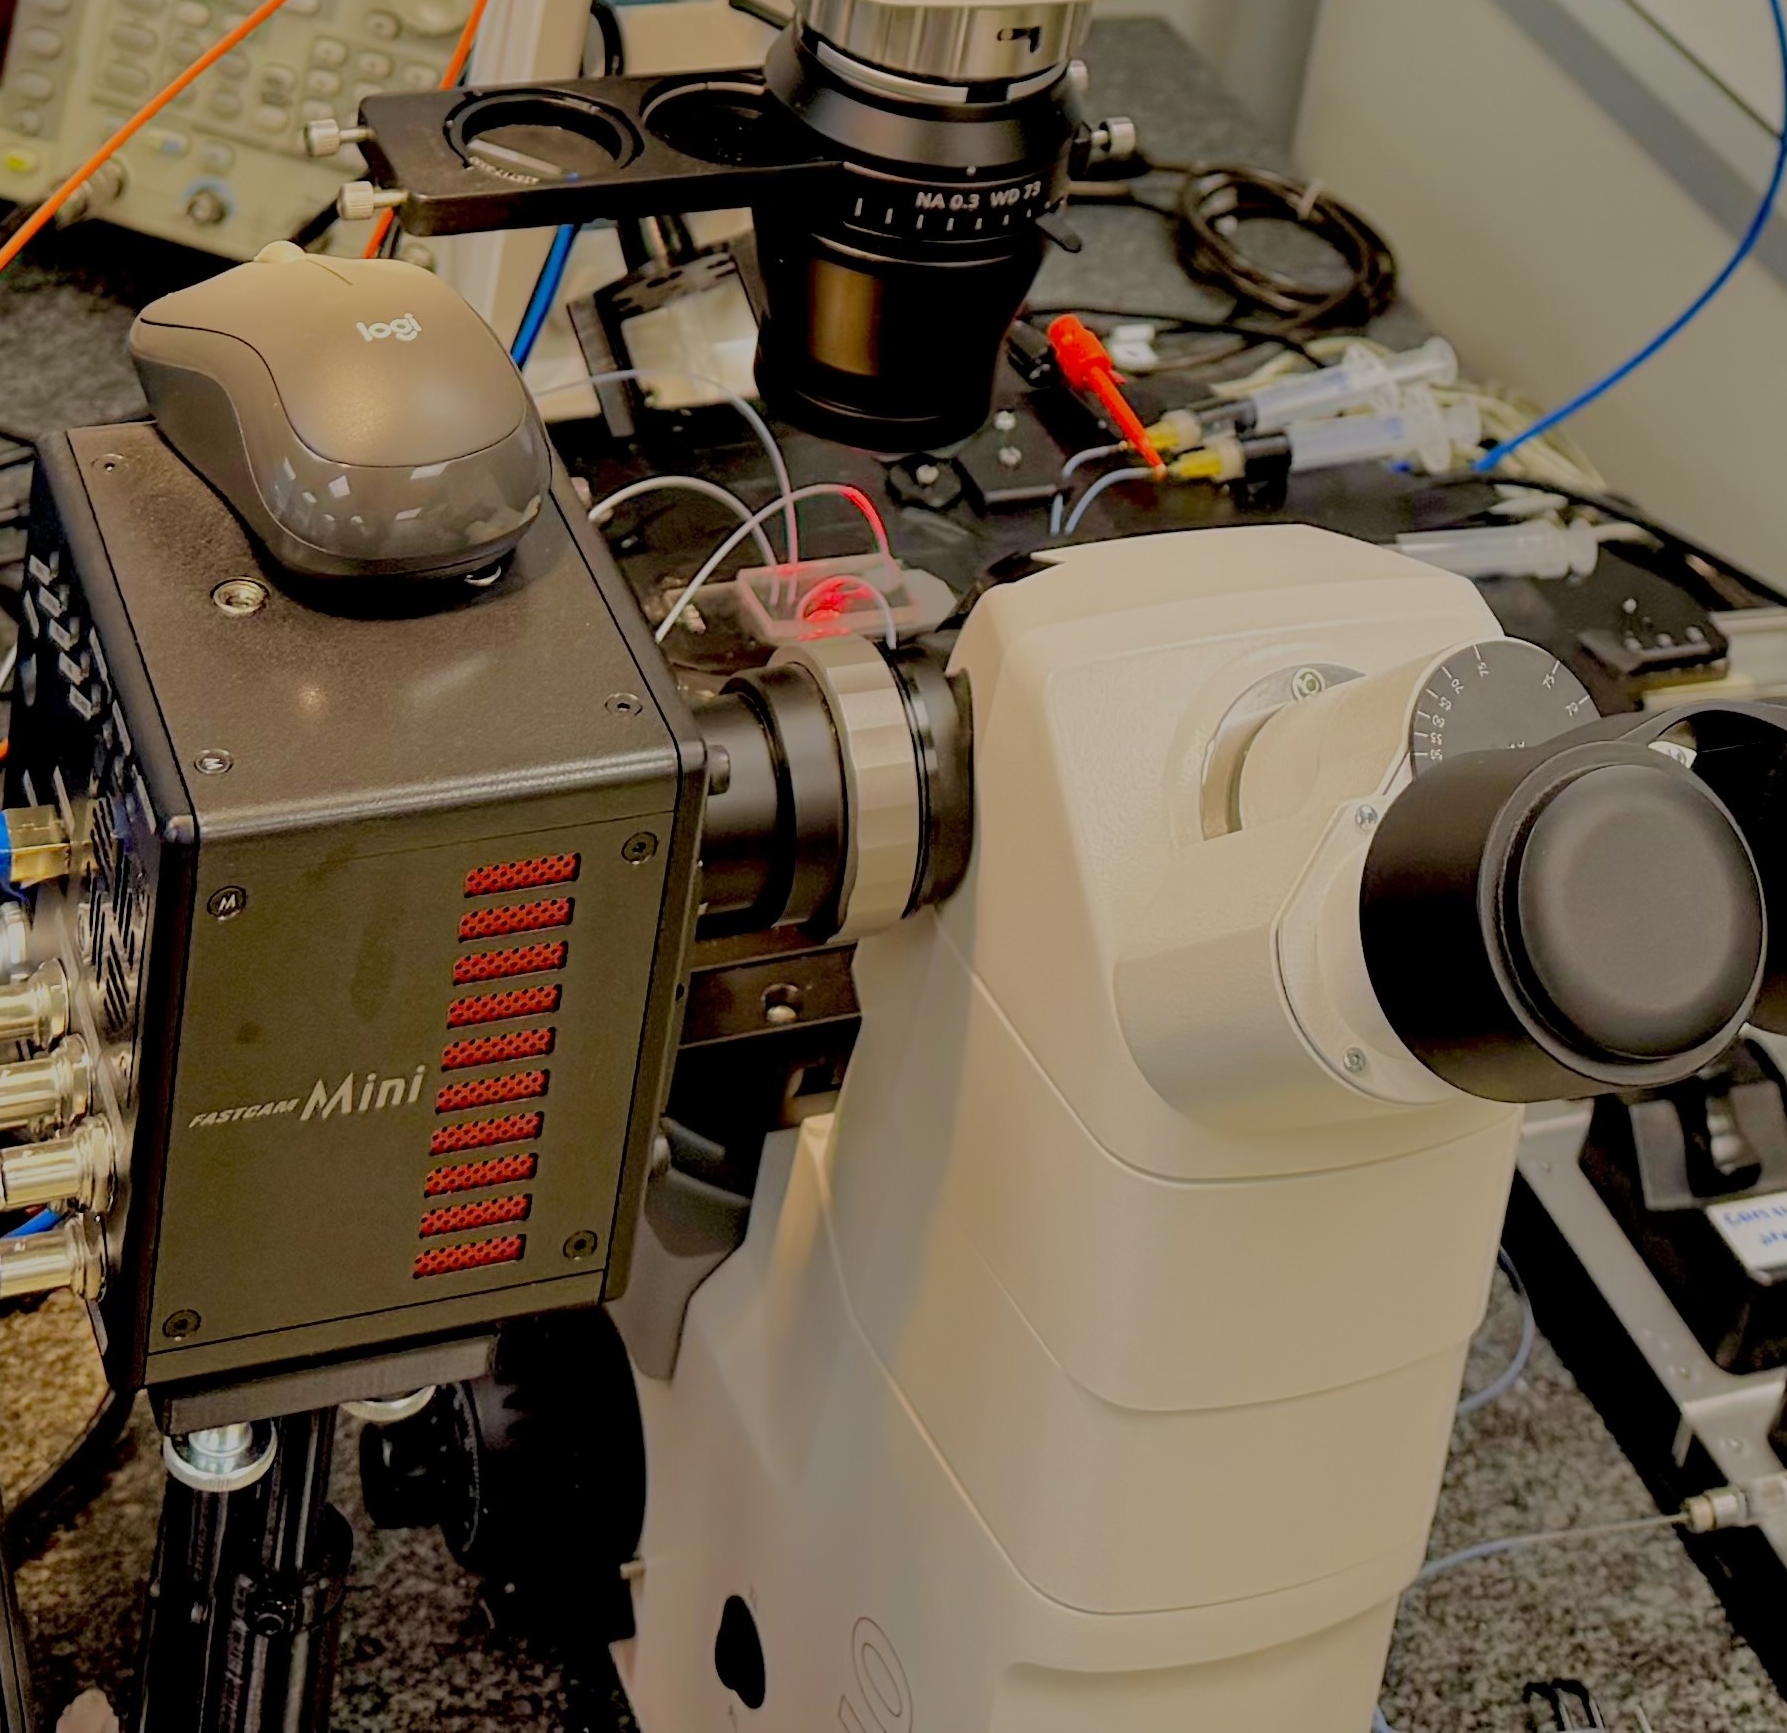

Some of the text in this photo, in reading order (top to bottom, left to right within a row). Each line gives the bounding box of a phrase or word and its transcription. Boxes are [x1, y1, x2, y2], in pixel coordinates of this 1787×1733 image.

[915, 190, 946, 210] NA
[949, 193, 980, 211] 0.3
[989, 188, 1020, 209] WD
[355, 312, 423, 345] logi
[188, 1064, 427, 1129] FASTCAM Mini
